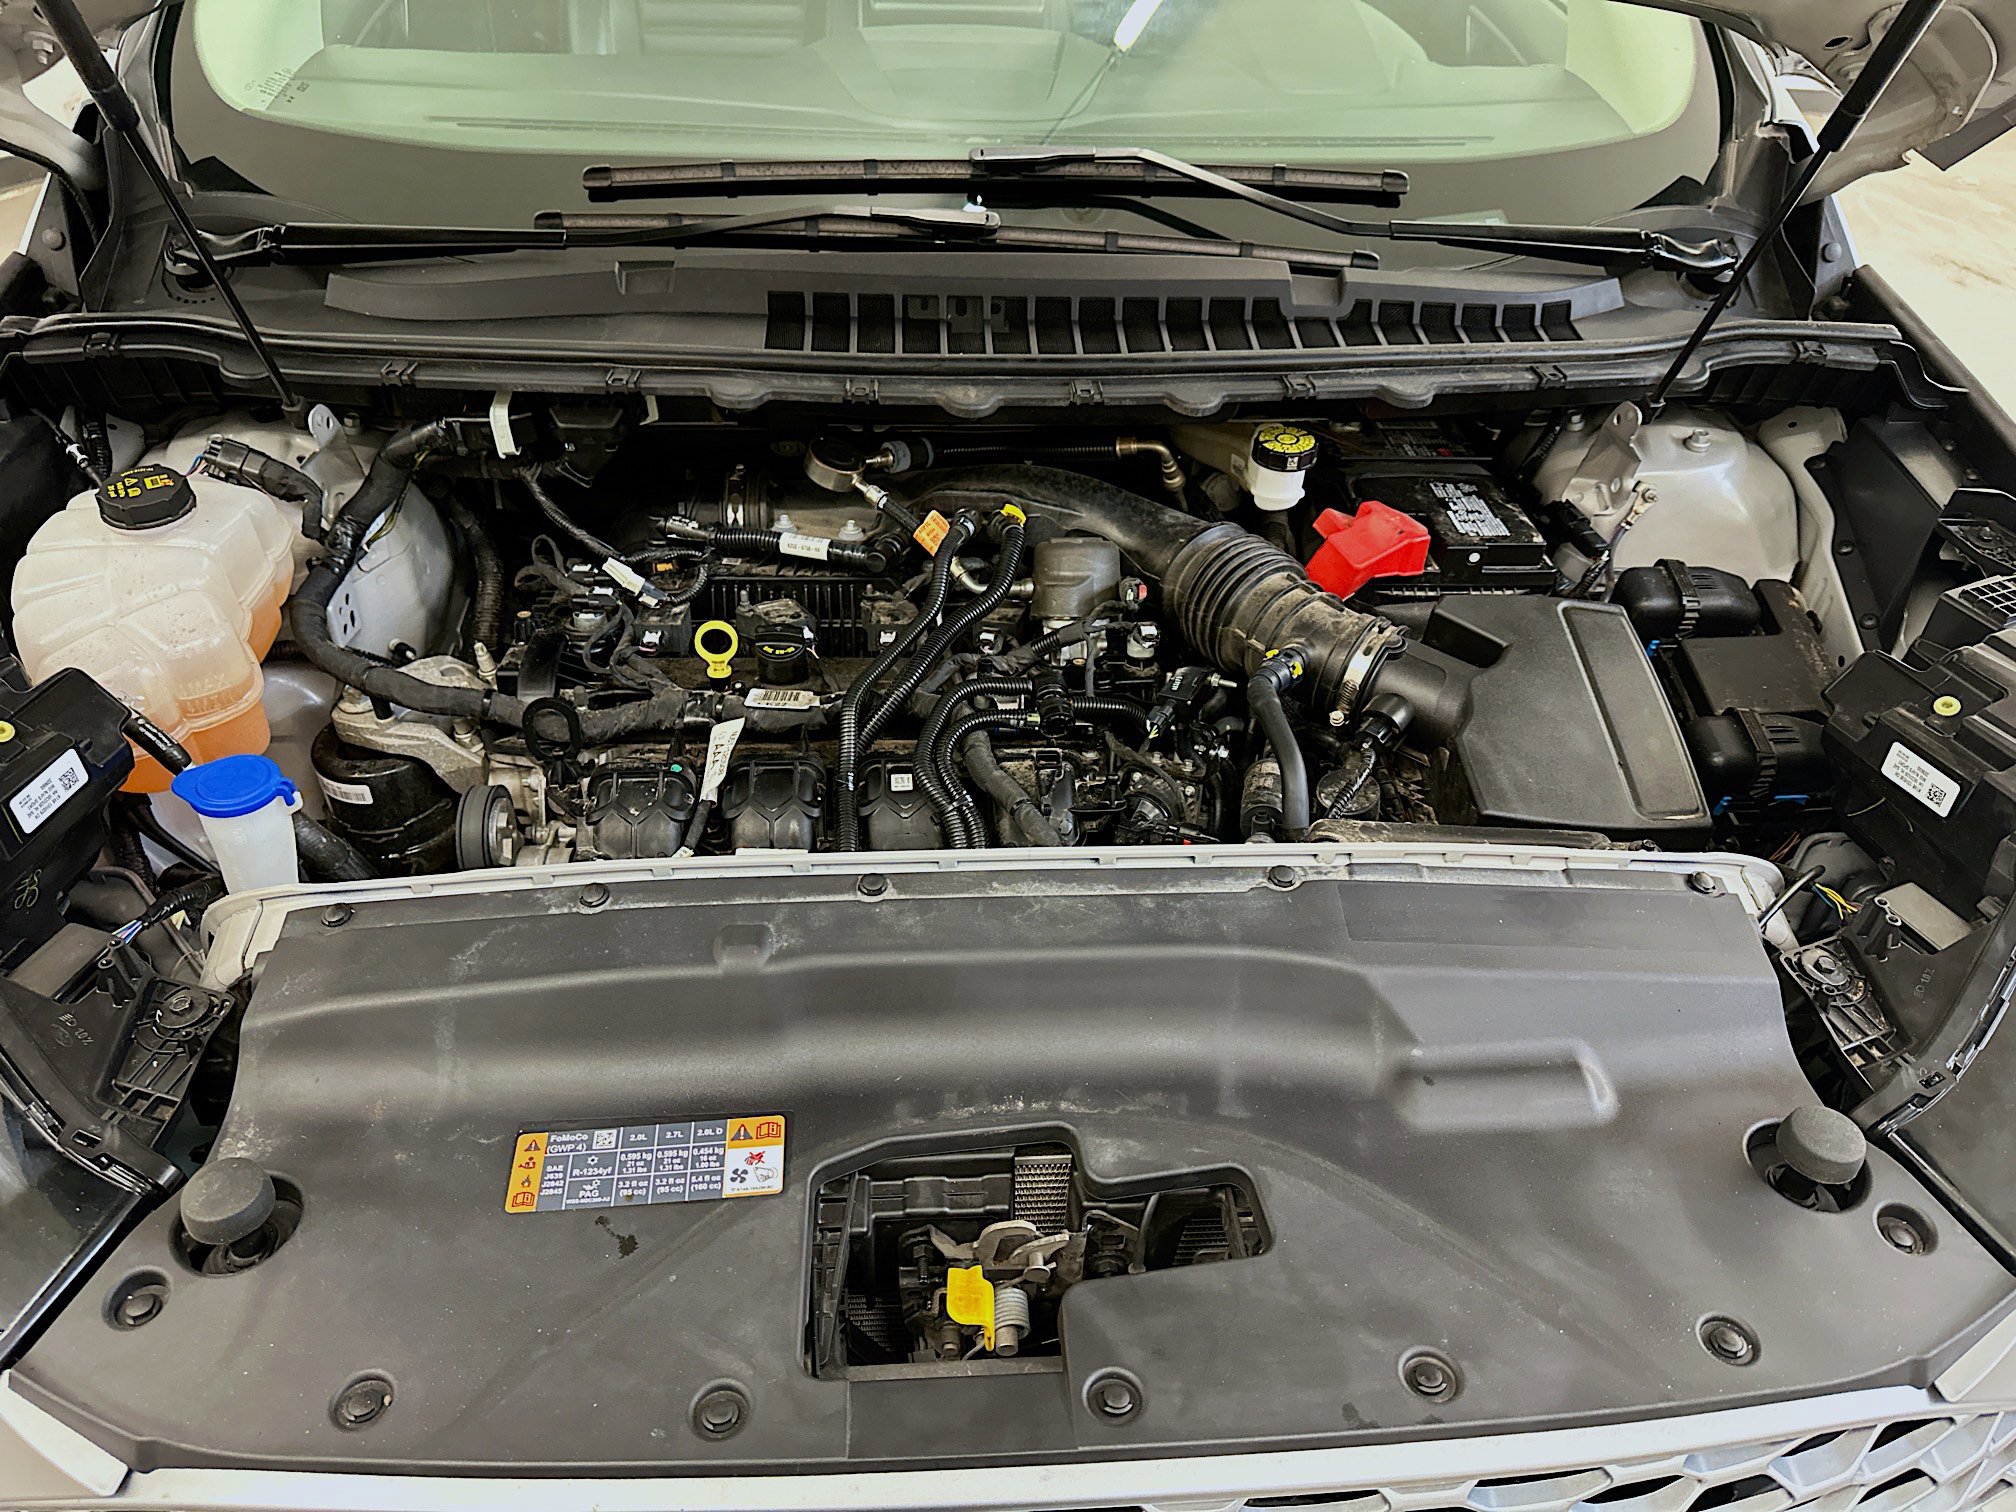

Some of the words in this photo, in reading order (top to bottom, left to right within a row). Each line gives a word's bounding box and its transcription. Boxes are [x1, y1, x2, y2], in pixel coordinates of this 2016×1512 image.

[550, 1133, 588, 1142] FoMoCo
[546, 1144, 574, 1154] (GWP
[576, 1144, 587, 1152] 4)
[657, 1150, 678, 1158] 0.595
[679, 1149, 688, 1158] kg
[692, 1147, 713, 1156] 0.454
[714, 1146, 724, 1155] kg
[642, 1152, 652, 1160] kg
[572, 1167, 612, 1176] R-1234yf
[657, 1186, 669, 1194] (95
[710, 1182, 721, 1190] cc)
[578, 1190, 599, 1198] PAG
